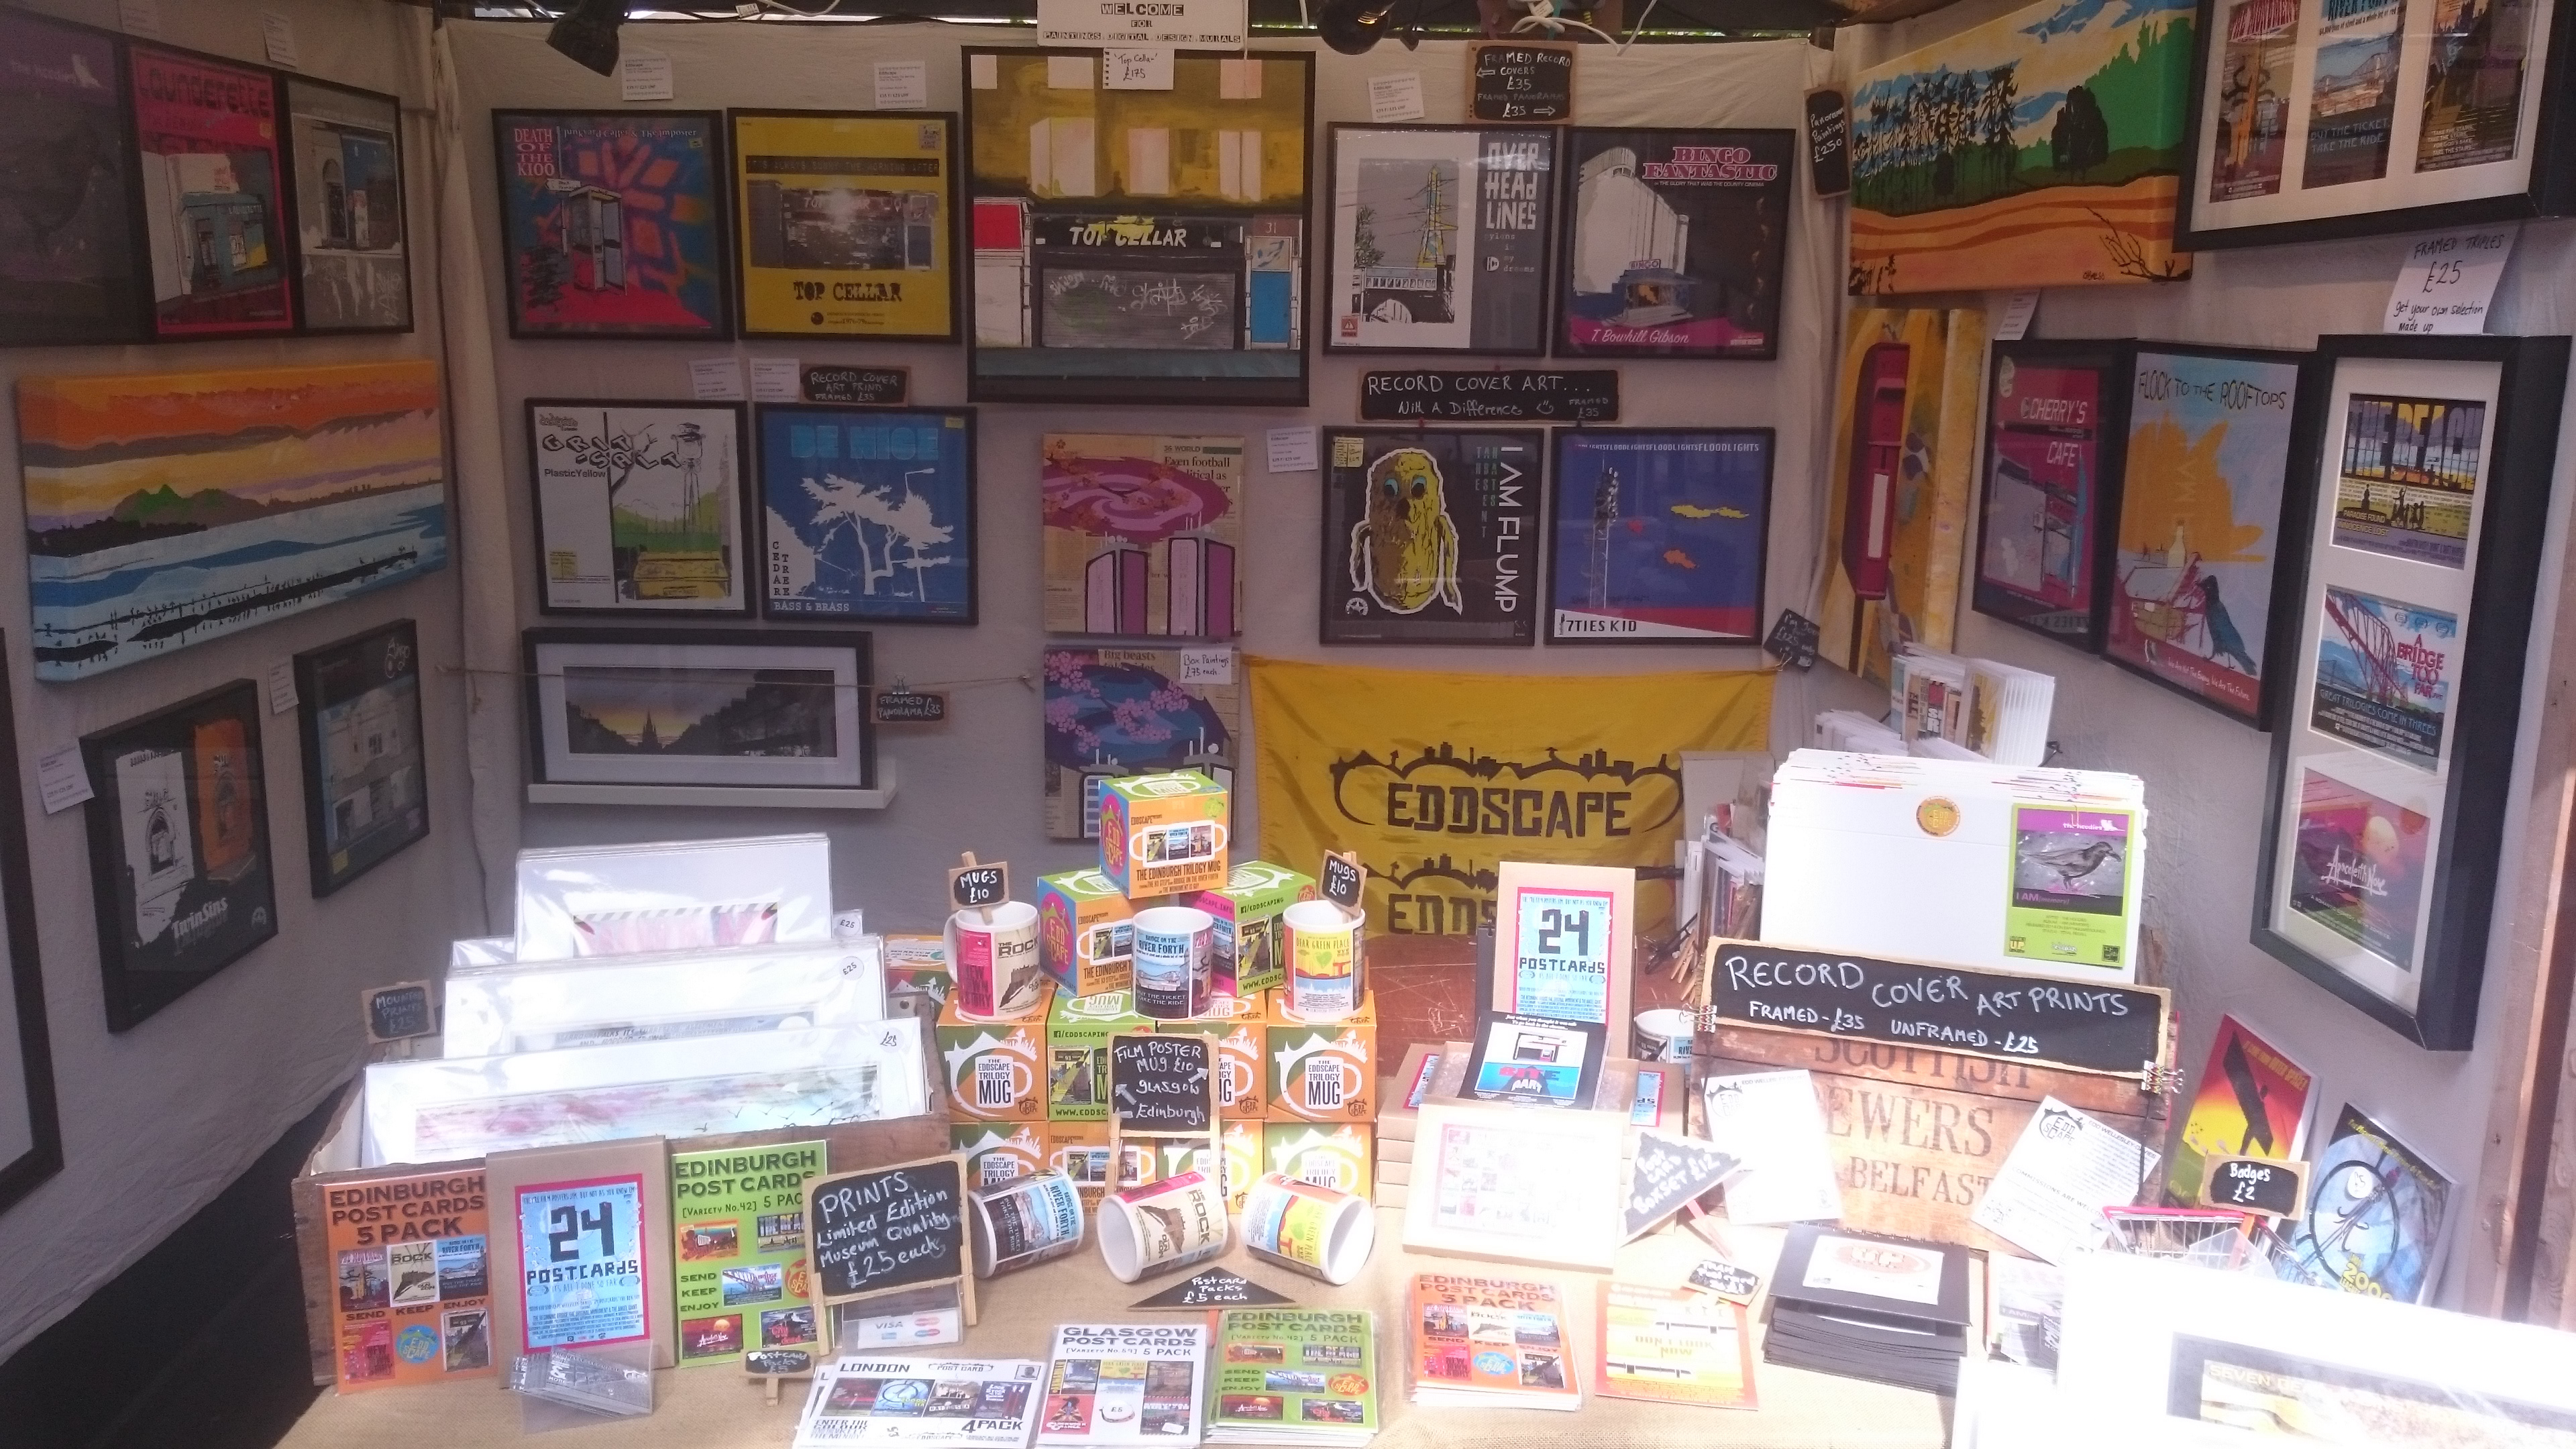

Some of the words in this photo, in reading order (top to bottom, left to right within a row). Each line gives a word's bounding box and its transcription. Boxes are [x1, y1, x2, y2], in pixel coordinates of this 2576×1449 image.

[1100, 3, 1184, 16] WELCOME
[1043, 32, 1101, 40] PAINTINGS
[1155, 34, 1193, 42] DESIGN
[1199, 35, 1241, 43] MURALS
[1485, 53, 1532, 66] FRAMED
[1500, 67, 1535, 75] COVERS
[1506, 76, 1532, 90] £35
[1503, 103, 1526, 117] £35
[515, 129, 552, 143] DEATH
[517, 143, 551, 152] OF
[1672, 147, 1750, 163] BINGO
[1815, 138, 1843, 163] £250
[517, 154, 553, 162] THE
[1488, 143, 1539, 170] OVER
[1642, 163, 1778, 181] FANTASTIC
[2414, 237, 2457, 259] FRAMED
[2466, 235, 2505, 250] TRIPLES
[1631, 260, 1660, 268] BINGO
[2422, 260, 2462, 293] £25
[793, 281, 825, 301] TOP
[833, 282, 902, 302] CELLAR
[2394, 300, 2408, 317] get
[2409, 304, 2430, 321] your
[2451, 301, 2483, 316] selection
[1601, 329, 1647, 342] Bowhill
[1649, 329, 1689, 343] Gibson
[811, 371, 858, 385] RECORD
[863, 374, 898, 387] COVER
[1367, 376, 1444, 396] RECORD
[1456, 376, 1512, 392] COVER
[826, 382, 846, 393] ART
[852, 383, 883, 393] PRINTS
[2139, 370, 2171, 400] FLOCK
[2175, 378, 2190, 396] TO
[2194, 383, 2215, 401] THE
[2220, 380, 2287, 411] ROOFTOPS
[815, 392, 852, 402] FRAMED
[1432, 402, 1442, 414] A
[1452, 400, 1523, 417] Difference
[850, 426, 939, 460] NICE
[1192, 455, 1230, 468] football
[2046, 441, 2077, 468] CAFE
[1216, 472, 1227, 480] as
[774, 600, 802, 612] BASS
[806, 602, 812, 611] &
[815, 602, 850, 612] BRASS
[1610, 619, 1638, 632] KID
[1124, 650, 1156, 661] beasts
[1183, 654, 1200, 666] Box
[1202, 653, 1230, 667] Paintings
[2397, 642, 2445, 670] BRIDGE
[2411, 663, 2439, 686] TOO
[879, 695, 923, 708] FRAMED
[1387, 782, 1632, 839] EDDSCAPE
[960, 870, 998, 888] MUGS
[1136, 869, 1147, 881] THE
[1148, 866, 1181, 879] EDINBURGH
[1183, 863, 1206, 875] TRILOGY
[1208, 861, 1221, 873] MUG
[1329, 875, 1347, 896] £10
[969, 888, 989, 904] £10
[1539, 909, 1589, 956] 24
[998, 937, 1040, 957] ROCK
[1158, 942, 1185, 954] FORTH
[1312, 940, 1330, 949] GREEN
[1334, 938, 1349, 949] PLACE
[1083, 967, 1093, 979] THE
[1095, 962, 1127, 977] EDINBURGH
[1725, 956, 1864, 991] RECORD
[1872, 975, 1968, 1008] COVER
[1977, 991, 2021, 1017] ART
[2027, 987, 2129, 1016] PRINTS
[1892, 1019, 1988, 1046] UNFRAMED
[1114, 1044, 1144, 1063] FILM
[1148, 1041, 1201, 1059] POSTER
[979, 1062, 1010, 1071] EDDSCAPE
[1173, 1057, 1194, 1073] £10
[1309, 1065, 1340, 1073] EDDSCAPE
[979, 1072, 1010, 1080] TRILOGY
[979, 1080, 1011, 1104] MUG
[1308, 1081, 1340, 1106] MUG
[1136, 1103, 1205, 1126] Edinburgh
[2089, 1120, 2100, 1130] EDD
[676, 1150, 817, 1179] EDINBURGH
[983, 1161, 1014, 1169] EDDSCAPE
[1689, 1153, 1721, 1183] £12
[2230, 1162, 2270, 1182] Badges
[984, 1169, 1015, 1177] TRILOGY
[329, 1176, 486, 1208] EDINBURGH
[677, 1177, 738, 1199] POST
[2233, 1185, 2255, 1202] £2
[763, 1195, 772, 1208] 5
[818, 1172, 910, 1224] PRINTS
[2061, 1193, 2075, 1201] ARE
[332, 1205, 397, 1226] POST
[402, 1195, 484, 1218] CARDS
[816, 1217, 877, 1248] Limited
[887, 1190, 948, 1222] Edition
[358, 1226, 374, 1245] 5
[381, 1217, 464, 1244] PACK
[549, 1201, 614, 1263] 24
[820, 1239, 879, 1267] Museum
[887, 1214, 951, 1241] Quality
[681, 1272, 717, 1283] SEND
[849, 1253, 896, 1288] £25
[1199, 1284, 1242, 1293] Packs
[1419, 1274, 1556, 1292] EDINBURGH
[682, 1287, 717, 1298] KEEP
[1214, 1292, 1248, 1301] each
[1421, 1283, 1477, 1295] POST
[1481, 1288, 1555, 1302] CARDS
[346, 1311, 385, 1321] SEND
[396, 1305, 433, 1316] KEEP
[443, 1299, 486, 1309] ENJOY
[680, 1301, 718, 1312] ENJOY
[1442, 1293, 1457, 1303] 5
[1462, 1295, 1536, 1311] PACK
[875, 1321, 904, 1329] VISA
[1228, 1312, 1363, 1324] EDINBURGH
[1063, 1326, 1198, 1338] GLASGOW
[1228, 1322, 1285, 1333] POST
[1290, 1323, 1362, 1334] CARDS
[1062, 1336, 1124, 1347] POST
[1128, 1336, 1197, 1347] CARDS
[1310, 1334, 1318, 1342] 5
[1322, 1334, 1358, 1344] PACK
[1143, 1348, 1151, 1356] 5
[1157, 1348, 1191, 1356] PACK
[1519, 1344, 1558, 1352] ENJOY
[839, 1363, 910, 1373] LONDON
[2210, 1365, 2272, 1388] SEVEN
[961, 1419, 977, 1434] 4
[976, 1419, 1024, 1430] PACK
